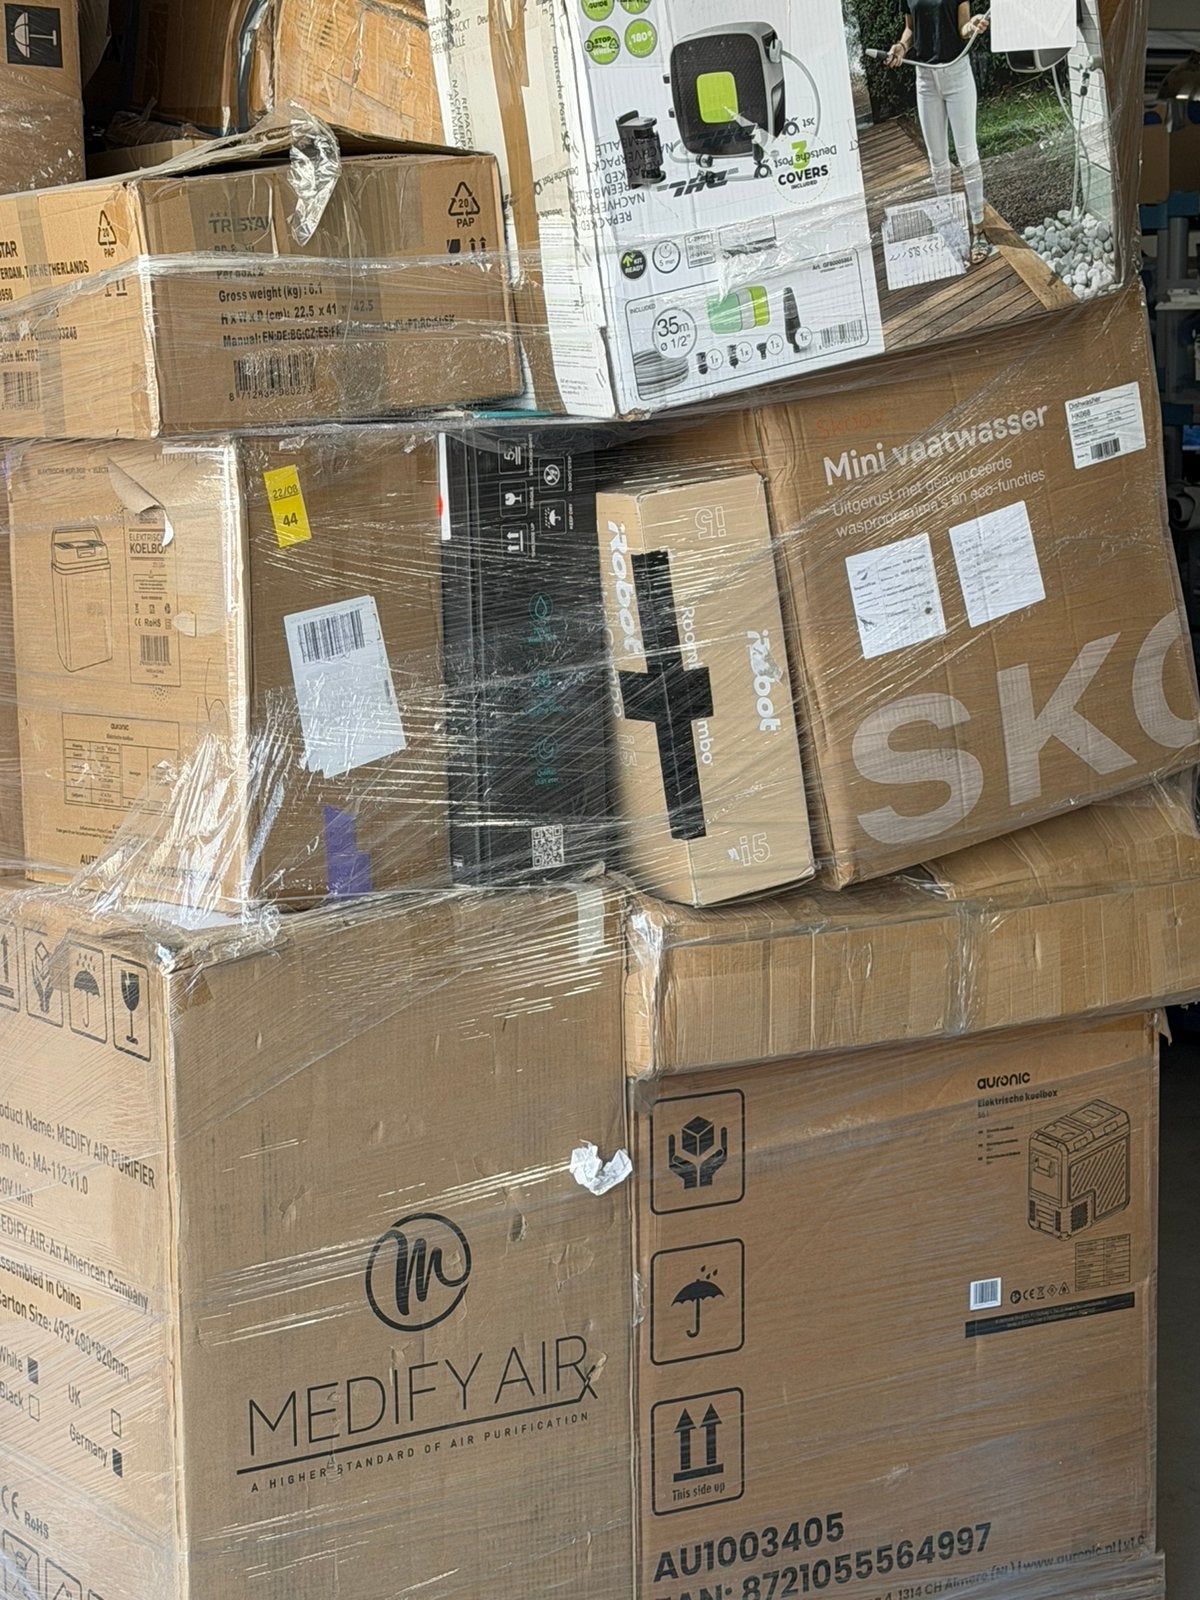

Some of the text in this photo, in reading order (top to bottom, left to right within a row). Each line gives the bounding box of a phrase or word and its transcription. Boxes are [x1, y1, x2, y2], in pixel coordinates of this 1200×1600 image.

[594, 36, 612, 44] STOP
[452, 79, 467, 150] NACHVERP
[462, 97, 474, 150] REPACK
[774, 156, 793, 168] Post
[795, 145, 837, 163] Deutsche
[778, 164, 829, 187] COVERS
[791, 179, 818, 190] INCLUDED
[458, 199, 469, 208] 20
[456, 217, 475, 228] PAP
[0, 260, 90, 281] ERDAM, THE NETHERLANDS
[219, 290, 247, 302] Gross
[249, 286, 282, 301] weight
[294, 305, 315, 319] 22.5
[326, 303, 337, 315] 41
[354, 301, 374, 313] 42.5
[629, 303, 656, 315] INCLUDED
[657, 316, 690, 337] 35m
[800, 333, 808, 341] 1x
[223, 332, 261, 348] Manual:
[771, 340, 780, 349] 1x
[711, 355, 719, 364] 1x
[741, 347, 749, 357] 1x
[1069, 396, 1101, 409] Dishwasher
[823, 443, 887, 487] Mini
[893, 405, 1049, 469] vaatwasser
[833, 457, 1013, 517] Uitgerust met geavanceerde
[970, 468, 1046, 500] eco-functies
[282, 512, 299, 527] 44
[130, 543, 167, 554] KOELBO
[608, 519, 644, 656] iRobot
[697, 719, 714, 765] mbo
[739, 832, 771, 867] i5
[977, 1072, 1031, 1090] auronic
[977, 1089, 1058, 1108] Elektrische koelbox
[25, 1110, 55, 1140] Name:
[57, 1123, 92, 1157] MEDIFY
[94, 1142, 109, 1166] AIR
[111, 1149, 156, 1190] PURIFIER
[0, 1213, 28, 1244] EDIFY
[64, 1248, 106, 1285] American
[107, 1269, 149, 1315] Company
[0, 1255, 82, 1311] ssembled in China
[29, 1303, 52, 1333] Size:
[68, 1384, 82, 1409] UK
[248, 1352, 484, 1457] MEDIFY
[69, 1423, 108, 1468] Germany
[251, 1411, 590, 1493] A HIGHER STANDARD OF AIR PURIFICATION
[672, 1482, 726, 1502] This side up
[24, 1509, 50, 1540] RoHS
[653, 1511, 845, 1583] AU1003405
[742, 1522, 992, 1600] 8721055564997
[924, 1581, 943, 1595] CH
